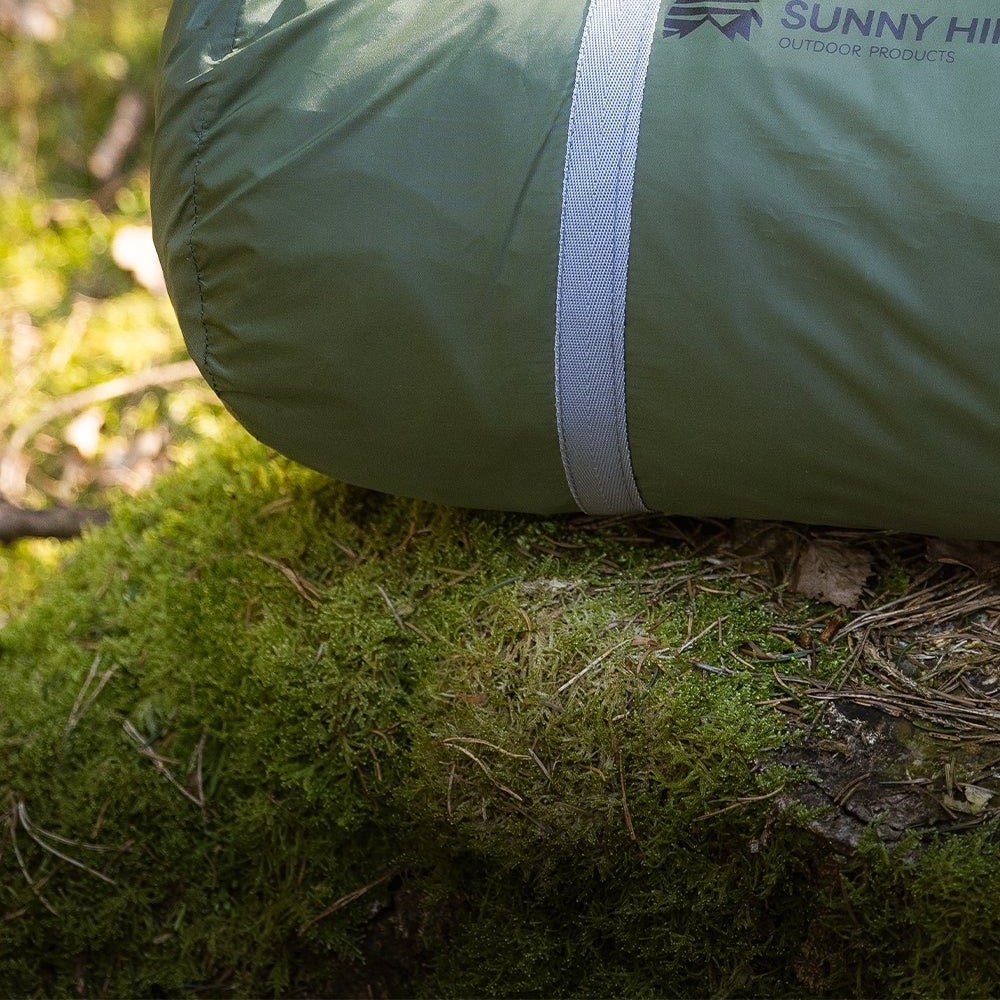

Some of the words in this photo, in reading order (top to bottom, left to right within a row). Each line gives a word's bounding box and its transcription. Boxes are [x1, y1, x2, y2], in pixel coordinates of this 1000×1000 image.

[780, 0, 938, 41] SUNNY
[778, 36, 862, 58] OUTDOOR
[869, 45, 956, 63] PRODUCTS
